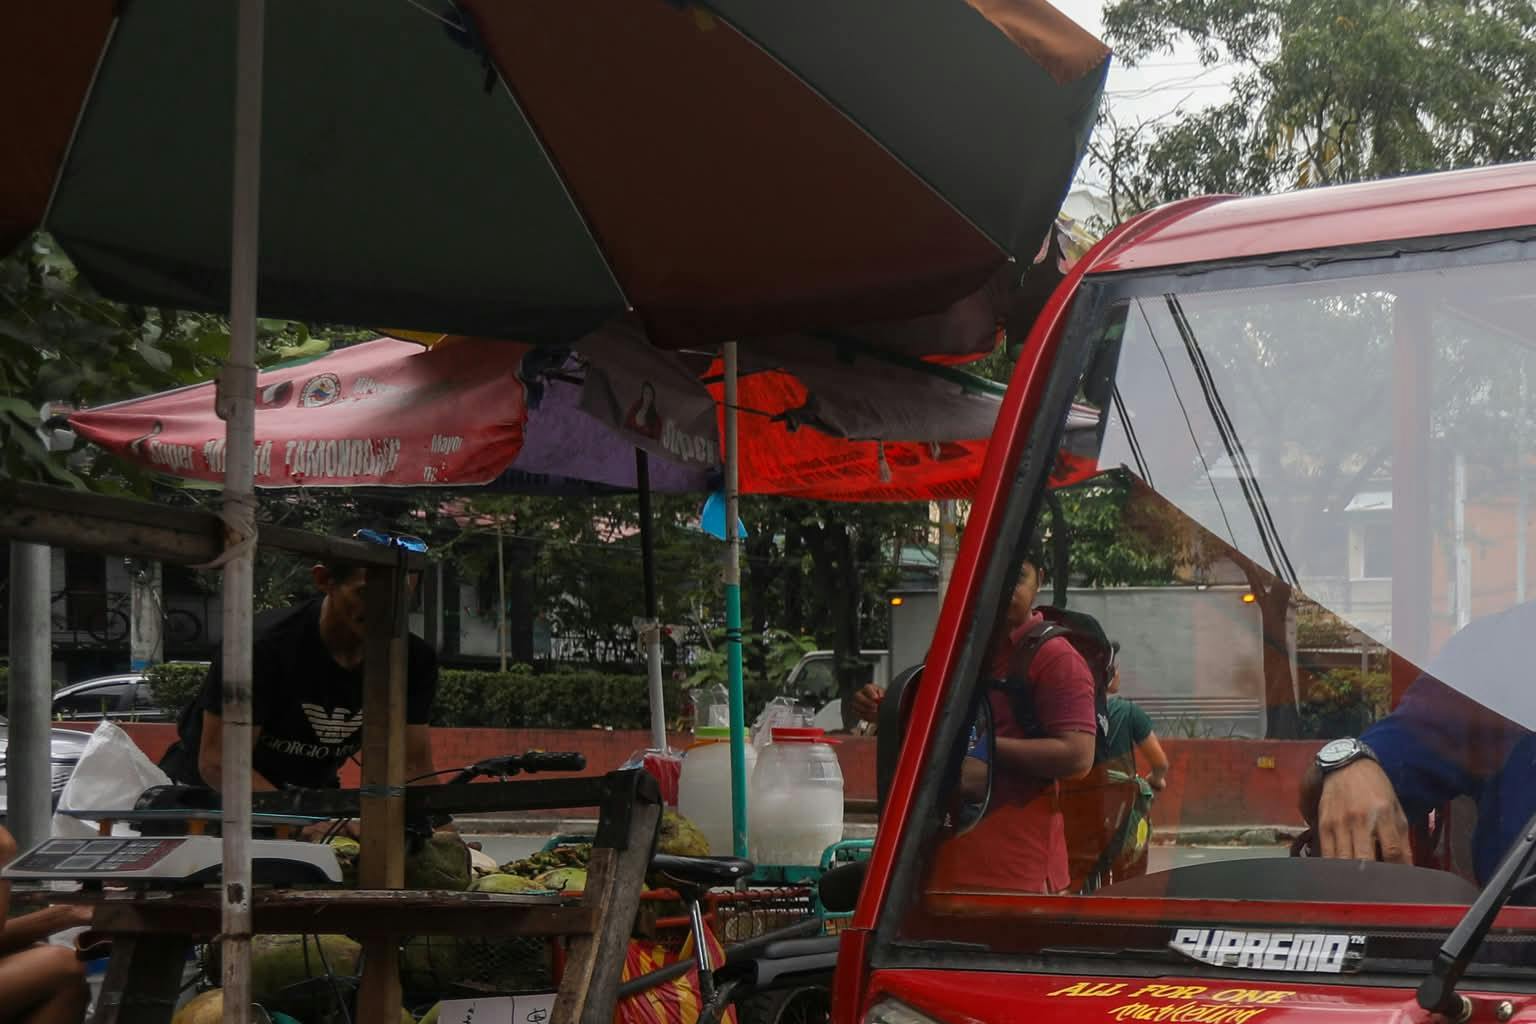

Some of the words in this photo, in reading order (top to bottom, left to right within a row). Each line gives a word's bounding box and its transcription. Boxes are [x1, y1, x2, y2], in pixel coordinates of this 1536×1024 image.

[1169, 928, 1350, 973] SUPREMO
[1047, 981, 1128, 997] ALL
[1128, 984, 1207, 1000] FOR
[1211, 988, 1297, 1004] ONE
